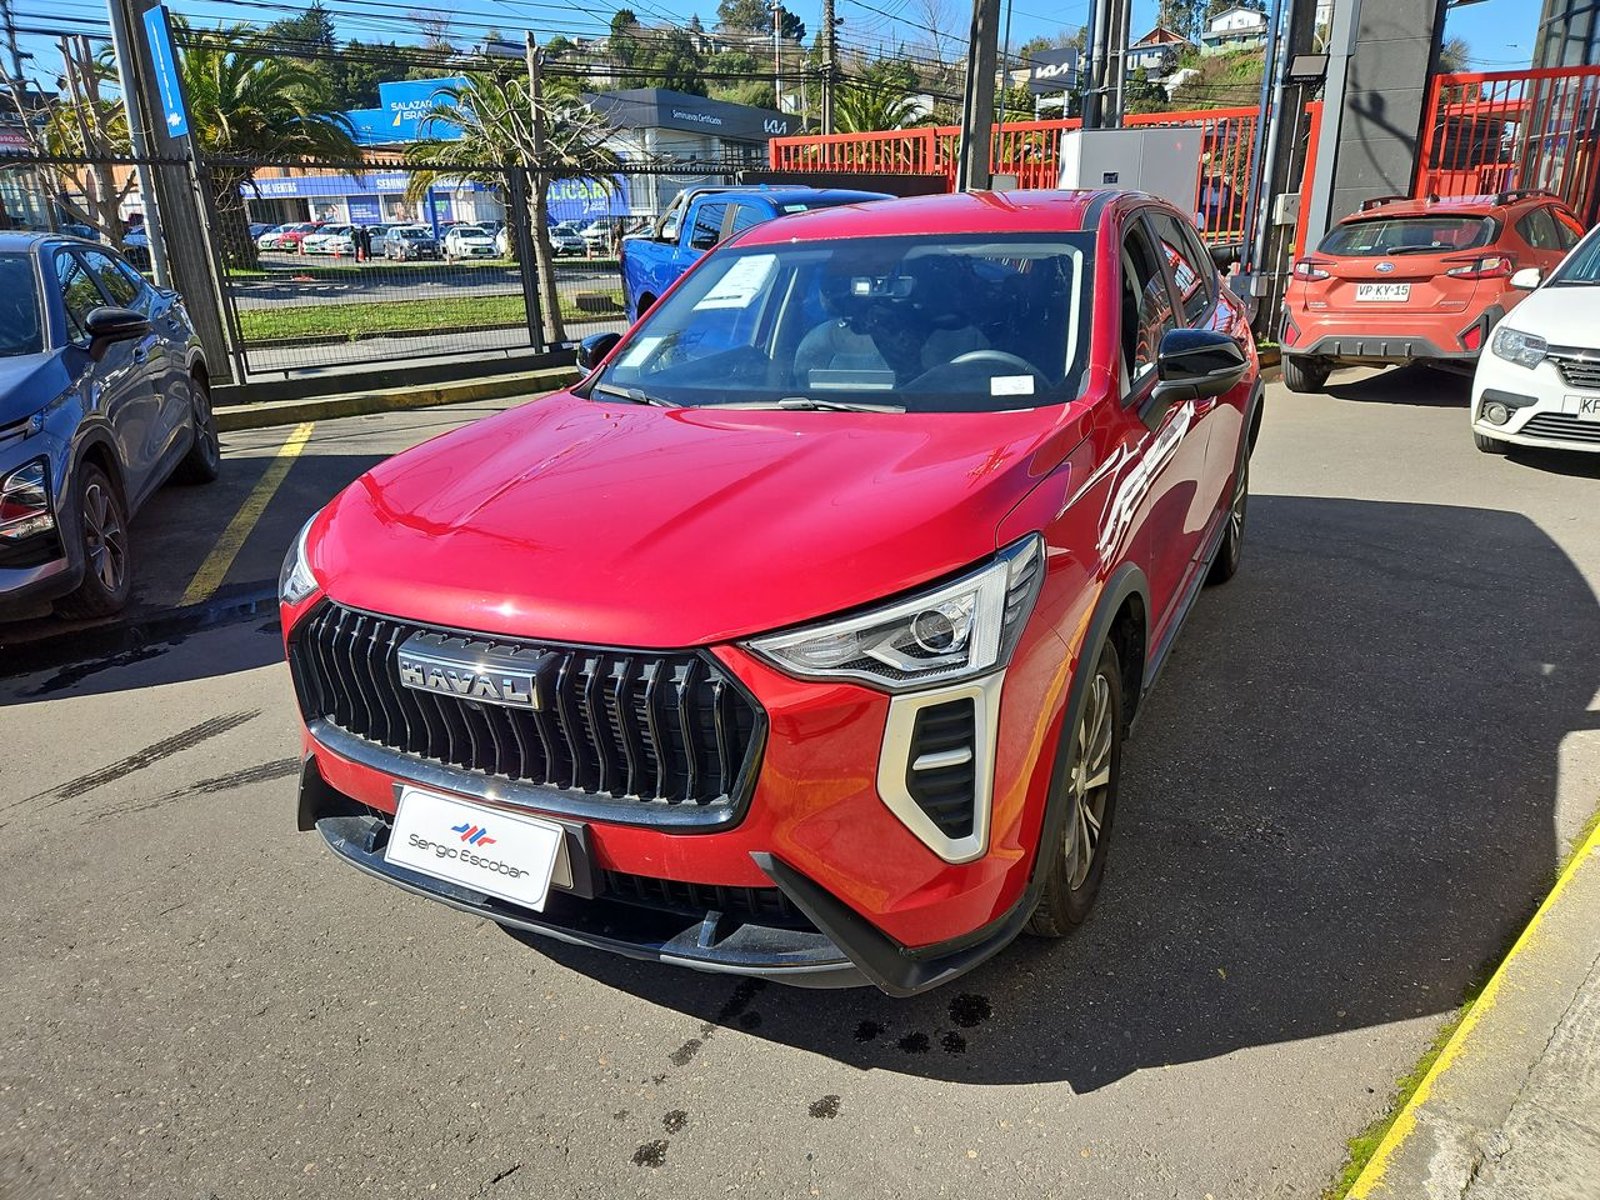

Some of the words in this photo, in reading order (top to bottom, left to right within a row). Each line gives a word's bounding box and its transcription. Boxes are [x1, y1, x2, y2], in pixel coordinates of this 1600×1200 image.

[391, 99, 432, 111] SALAZAR
[672, 109, 697, 122] Seminuevos
[698, 113, 722, 126] Certificados
[764, 118, 787, 135] KIA
[402, 662, 529, 702] HAVAL
[460, 849, 529, 879] Escobar
